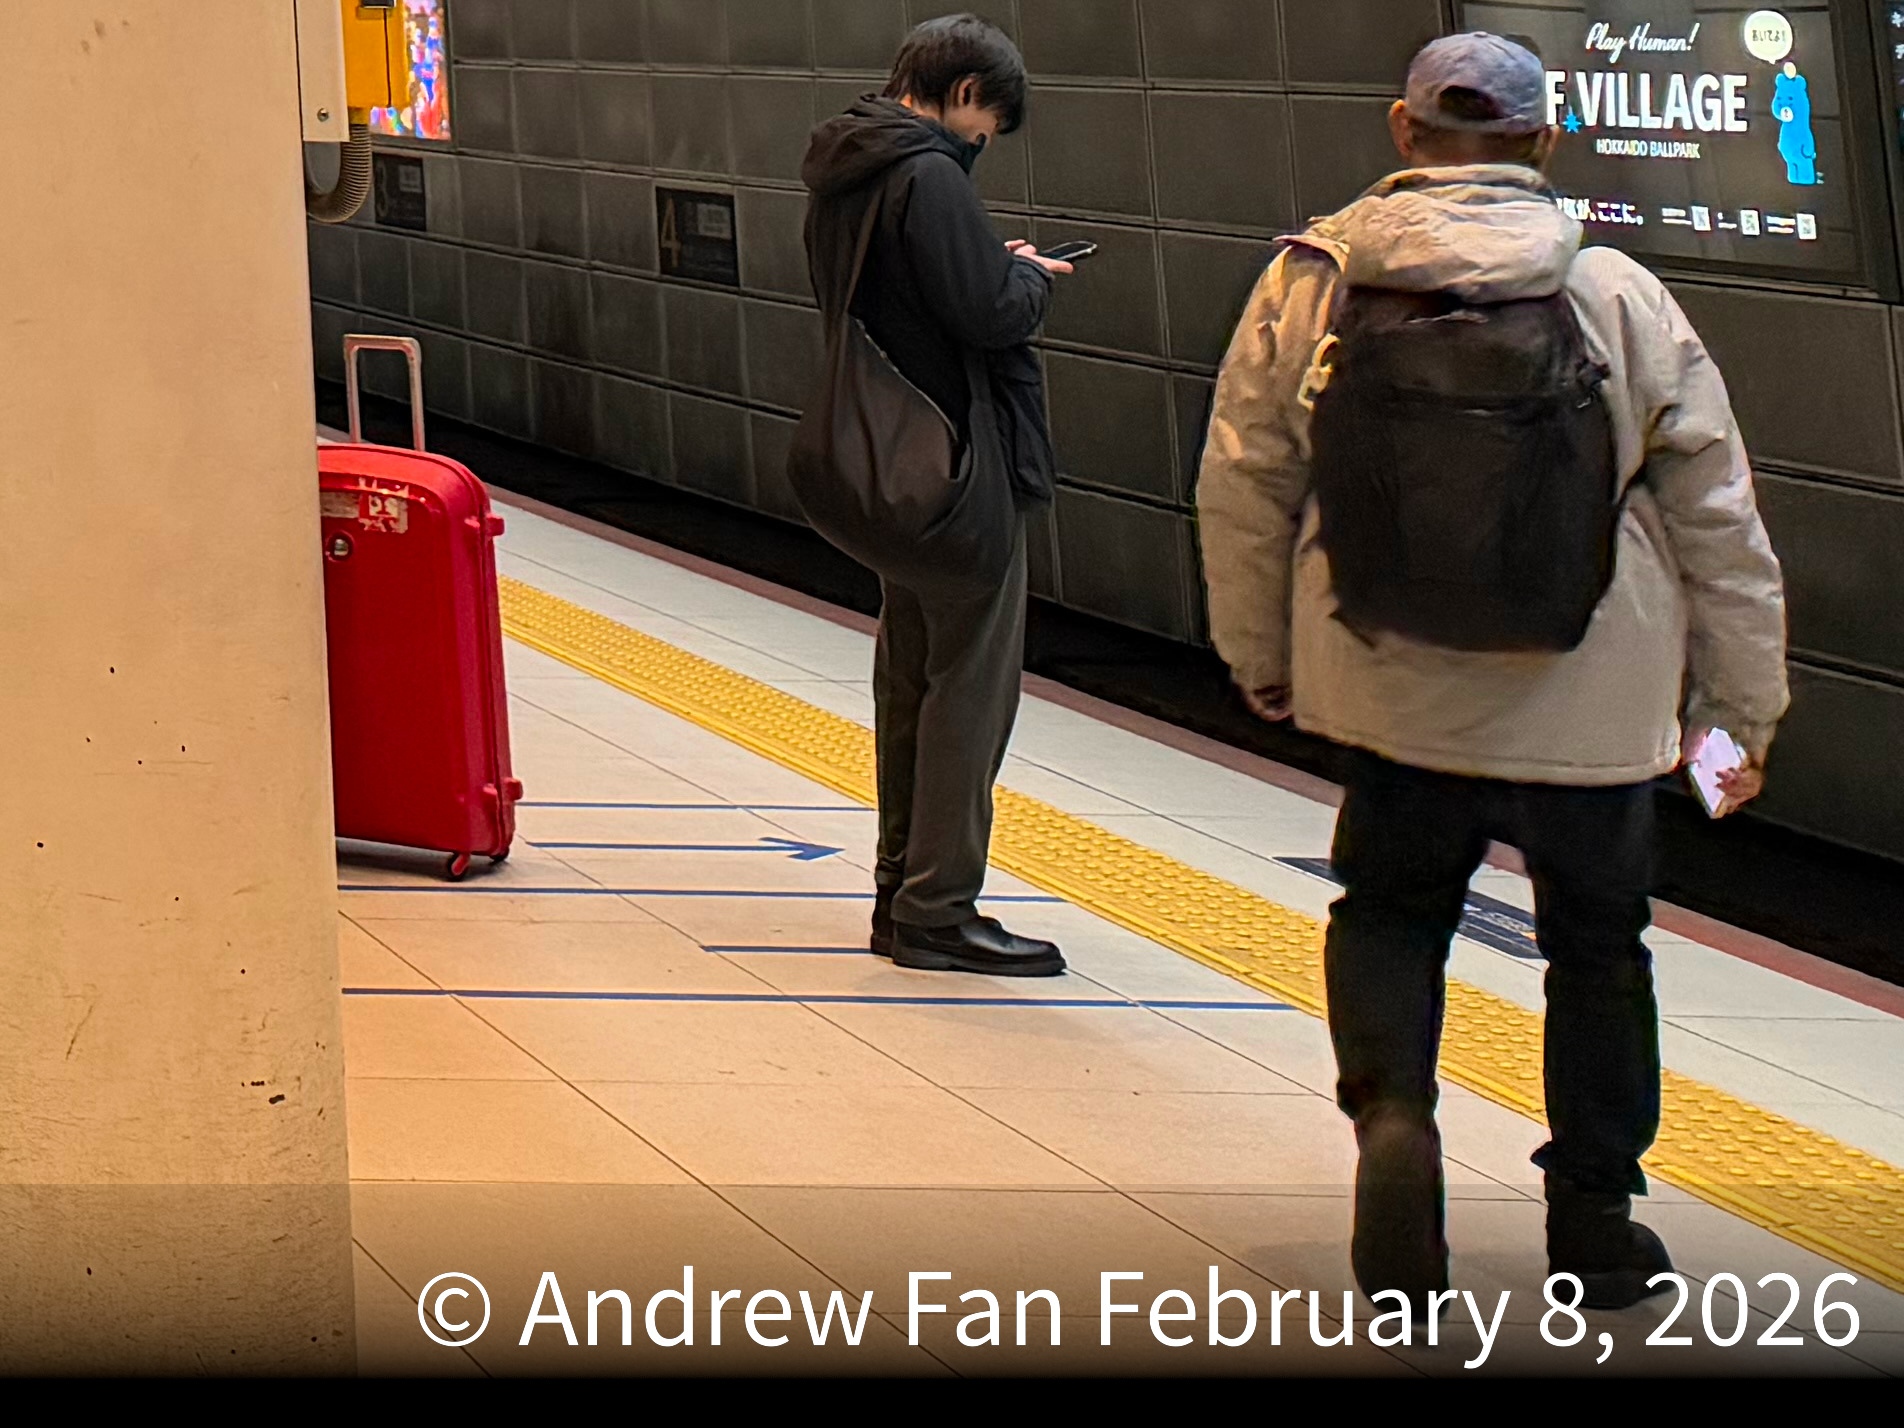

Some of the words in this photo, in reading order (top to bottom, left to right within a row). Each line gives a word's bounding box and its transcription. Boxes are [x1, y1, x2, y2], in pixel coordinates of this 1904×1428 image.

[1586, 22, 1626, 63] Play
[1629, 22, 1700, 52] Human!
[1575, 71, 1748, 132] VILLAGE
[1596, 138, 1648, 156] HOKKAIDO
[1650, 141, 1701, 159] BALLPARK
[661, 199, 681, 268] 4
